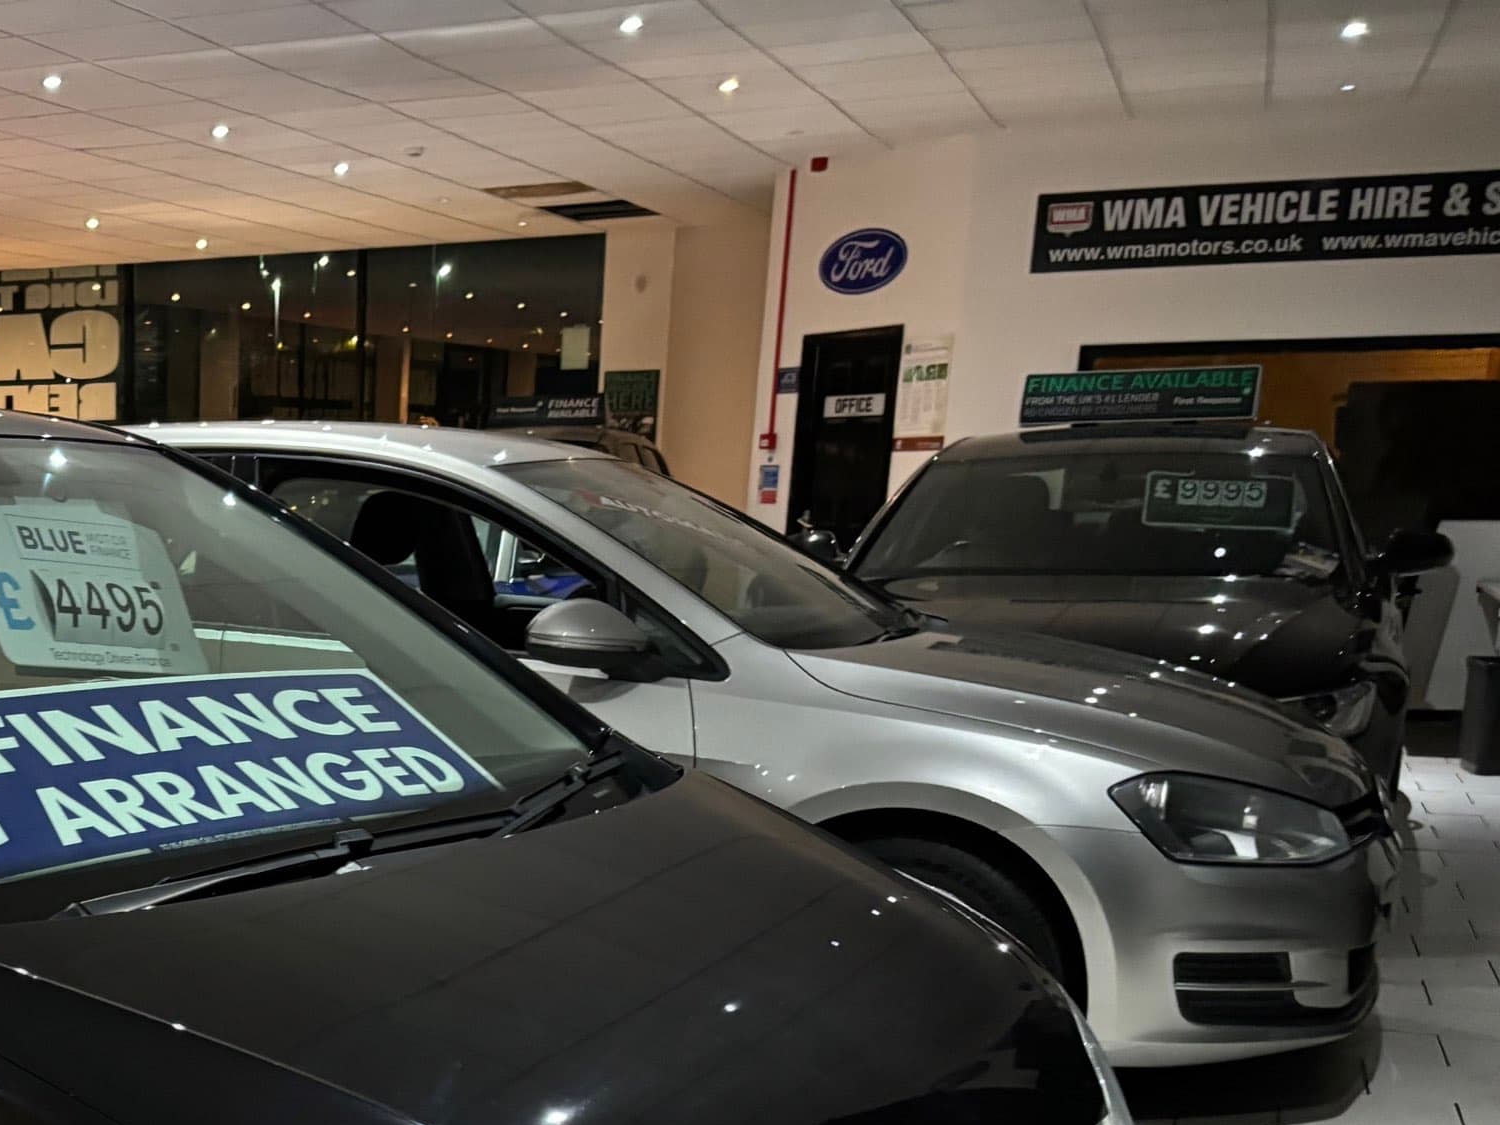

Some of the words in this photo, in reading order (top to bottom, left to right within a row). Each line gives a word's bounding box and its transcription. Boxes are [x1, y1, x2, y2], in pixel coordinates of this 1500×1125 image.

[1103, 197, 1186, 231] WMA
[1199, 188, 1340, 227] VEHICLE
[1349, 184, 1432, 221] HIRE
[1443, 182, 1471, 217] &
[831, 239, 894, 282] Ford
[1049, 234, 1303, 263] www.wmamotors.co.uk
[1028, 373, 1125, 394] FINANCE
[1131, 369, 1256, 391] AVAILABLE
[547, 397, 599, 410] FINANCE
[835, 396, 874, 414] OFFICE
[1181, 480, 1264, 502] 9995
[16, 525, 87, 555] BLUE
[56, 578, 164, 636] 4495
[35, 745, 466, 847] ARRANGED
